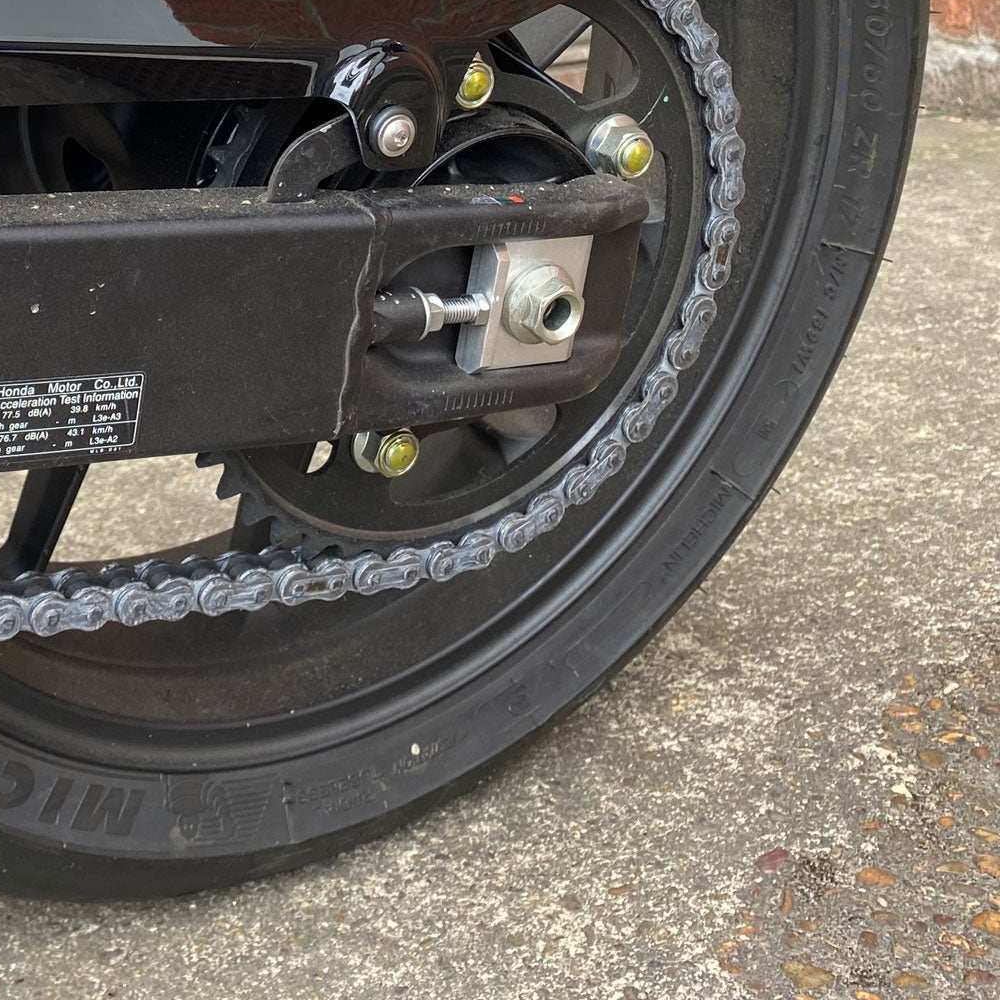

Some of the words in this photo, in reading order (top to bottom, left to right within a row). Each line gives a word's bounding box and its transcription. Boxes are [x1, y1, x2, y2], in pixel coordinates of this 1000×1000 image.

[48, 382, 82, 393] Motor
[60, 394, 80, 405] Test
[83, 389, 139, 403] Information
[2, 410, 21, 419] 77.5
[27, 408, 52, 418] dB(A)
[70, 405, 89, 414] 39.8
[95, 402, 117, 412] km/h
[8, 421, 29, 432] gear
[92, 412, 122, 423] L3e-A3
[0, 434, 17, 443] 76.7
[24, 431, 49, 441] dB(A)
[67, 428, 85, 437] 43.1
[92, 426, 114, 435] km/h
[5, 444, 26, 455] gear
[64, 440, 73, 448] m
[89, 435, 119, 446] L3e-A2
[661, 485, 733, 572] MICHELIN
